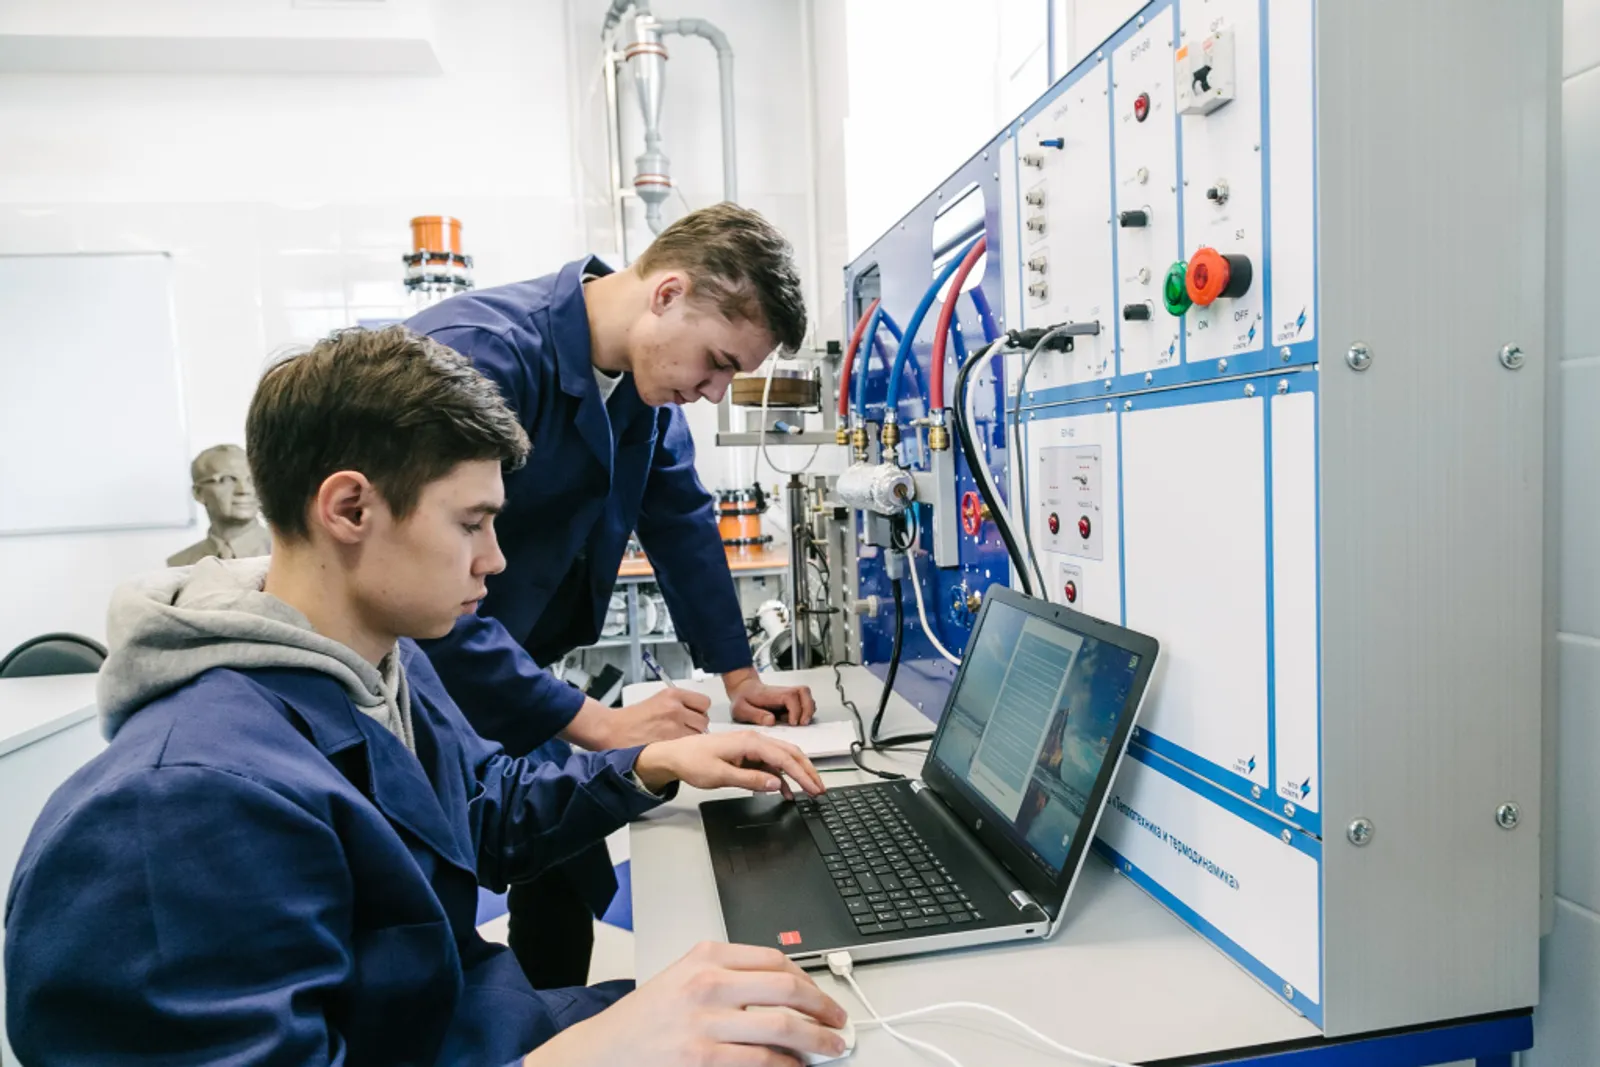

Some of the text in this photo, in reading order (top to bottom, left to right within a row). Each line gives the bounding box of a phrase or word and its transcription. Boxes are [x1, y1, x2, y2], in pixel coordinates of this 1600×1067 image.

[1234, 310, 1248, 321] OFF
[1198, 320, 1209, 330] ON
[1168, 835, 1240, 891] термодинамика»
